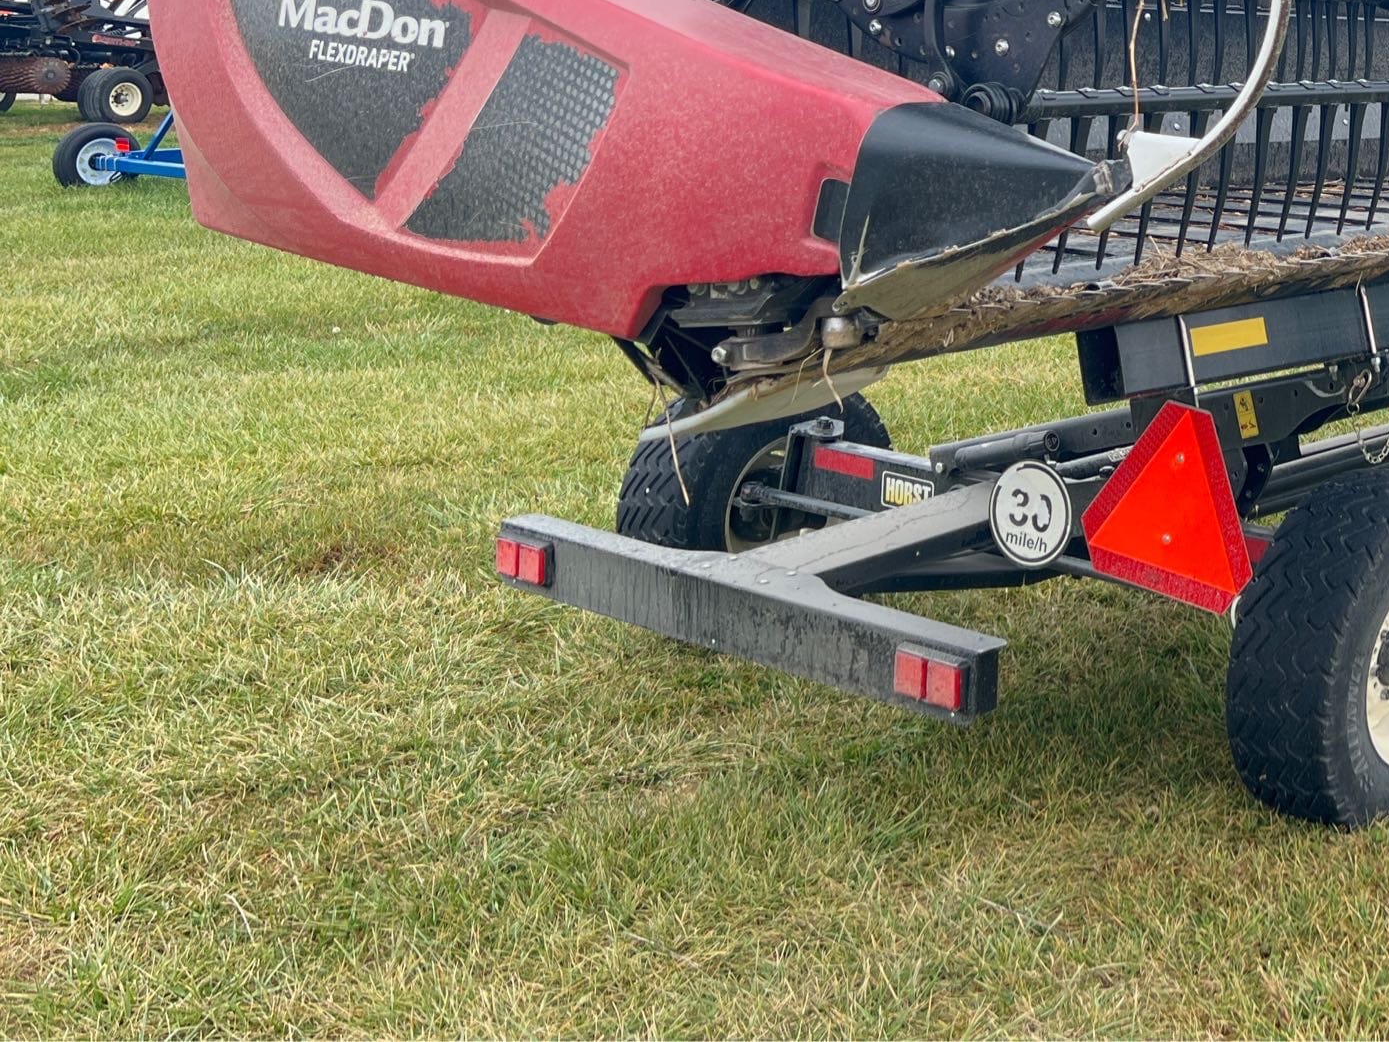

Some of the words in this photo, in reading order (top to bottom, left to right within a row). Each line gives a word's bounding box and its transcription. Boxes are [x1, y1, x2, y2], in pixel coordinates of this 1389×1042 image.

[308, 39, 413, 72] FLEXDRAPER
[885, 477, 931, 506] HORST
[1008, 488, 1052, 533] 30
[1005, 530, 1048, 554] mile/h
